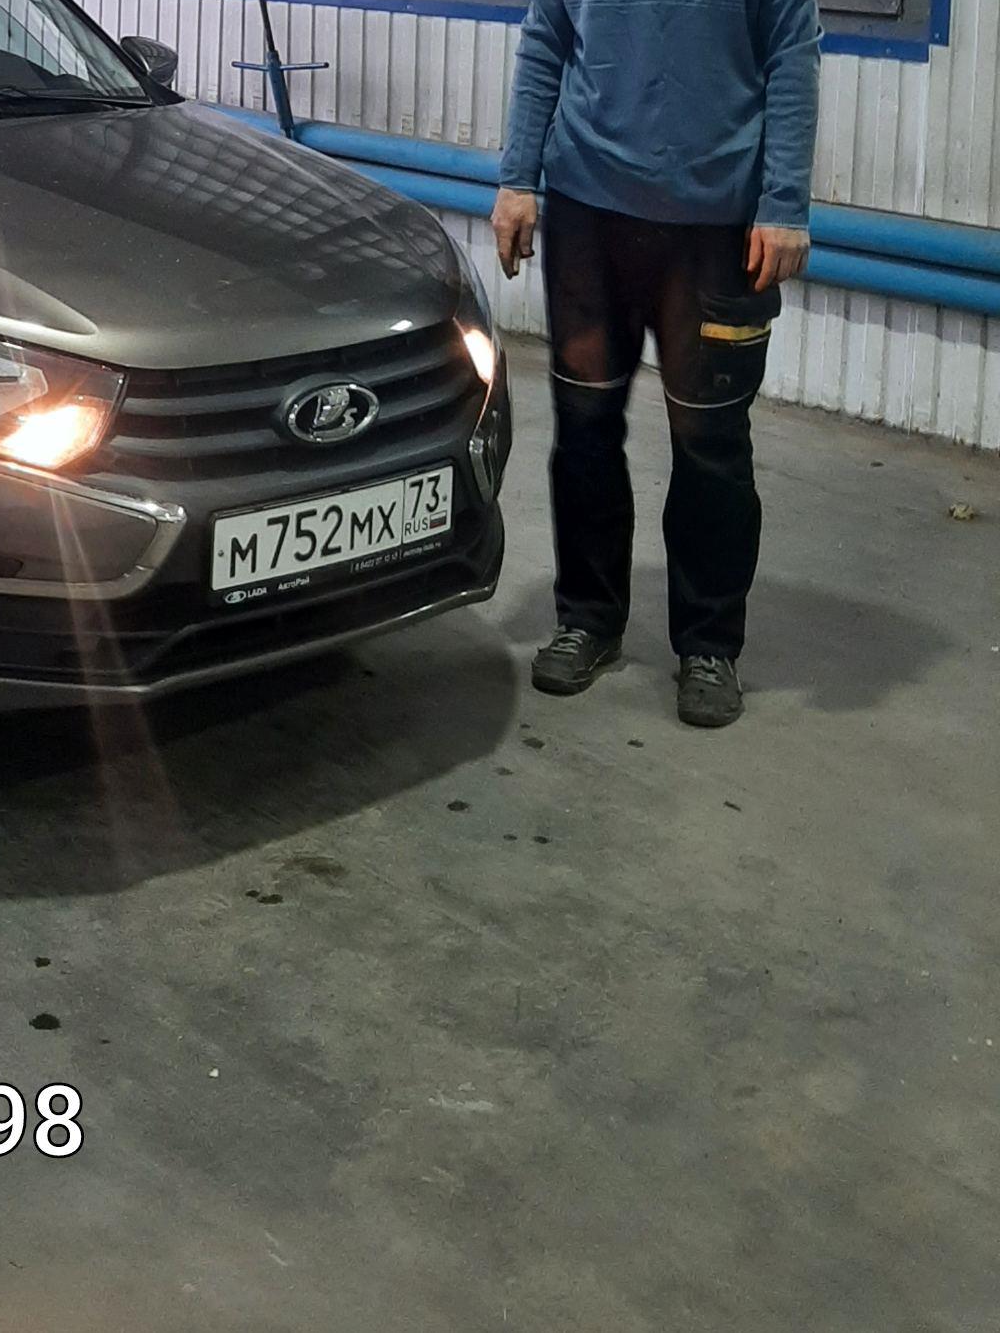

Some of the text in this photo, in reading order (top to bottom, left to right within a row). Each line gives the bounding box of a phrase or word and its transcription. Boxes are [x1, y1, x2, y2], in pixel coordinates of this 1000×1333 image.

[409, 475, 440, 518] 73
[404, 517, 429, 536] RUS
[247, 587, 267, 598] LADA
